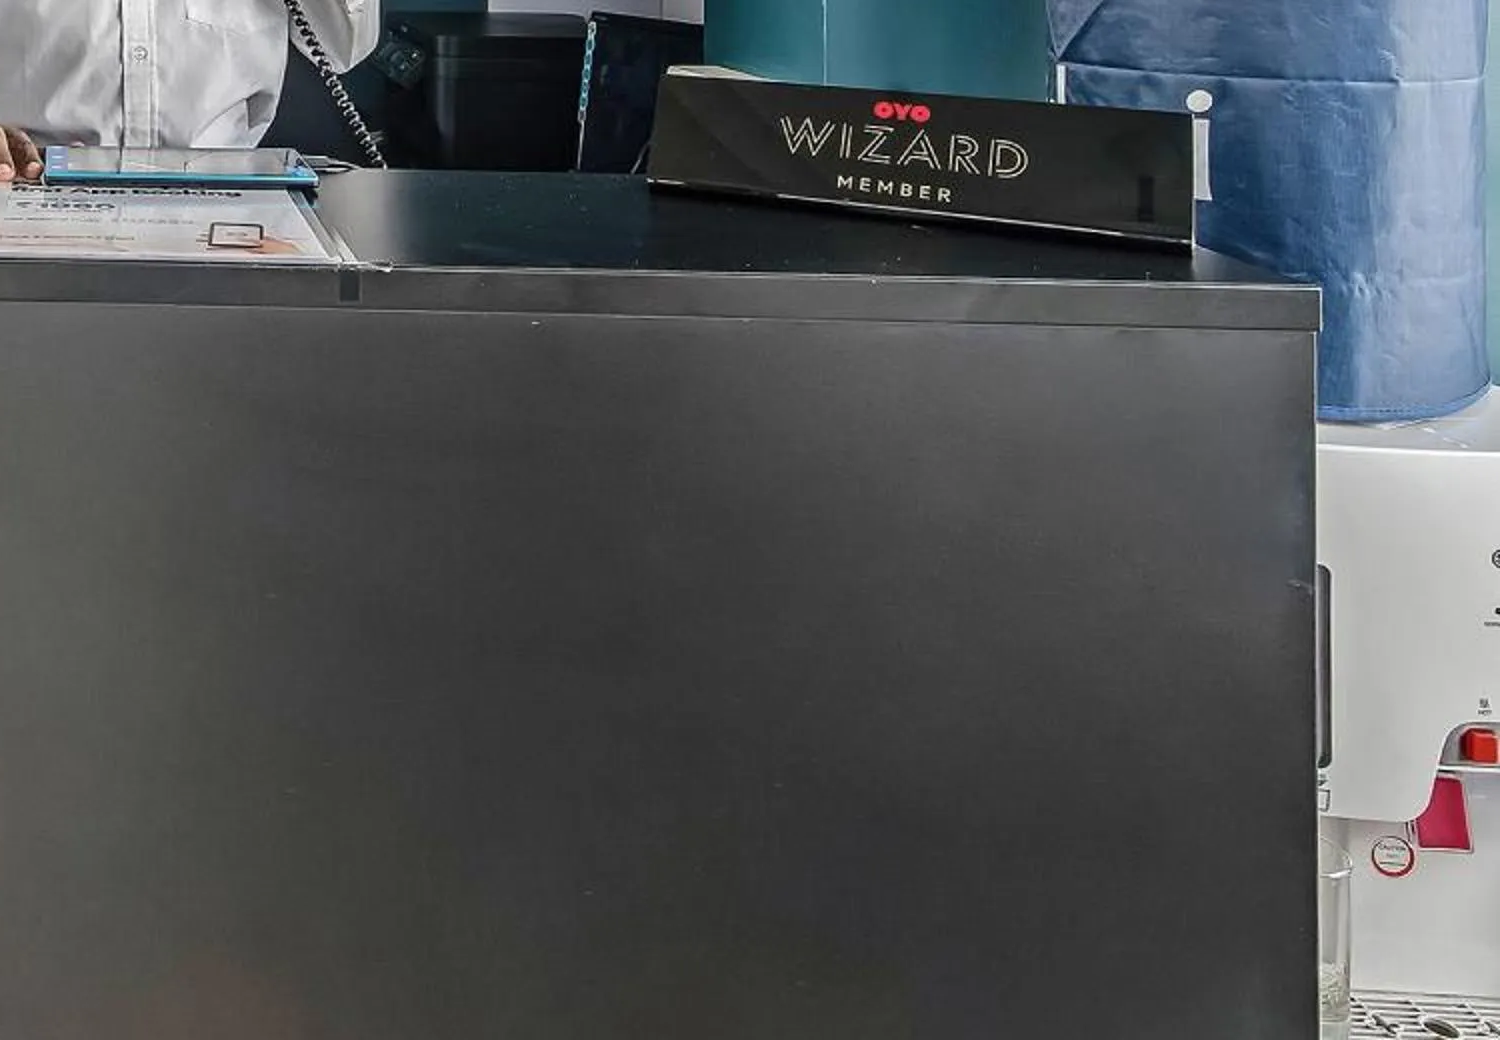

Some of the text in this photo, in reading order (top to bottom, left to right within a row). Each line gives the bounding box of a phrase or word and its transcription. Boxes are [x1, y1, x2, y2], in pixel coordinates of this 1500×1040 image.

[873, 100, 932, 124] OYO
[779, 115, 1030, 180] WIZARD
[836, 175, 954, 204] MEMBER
